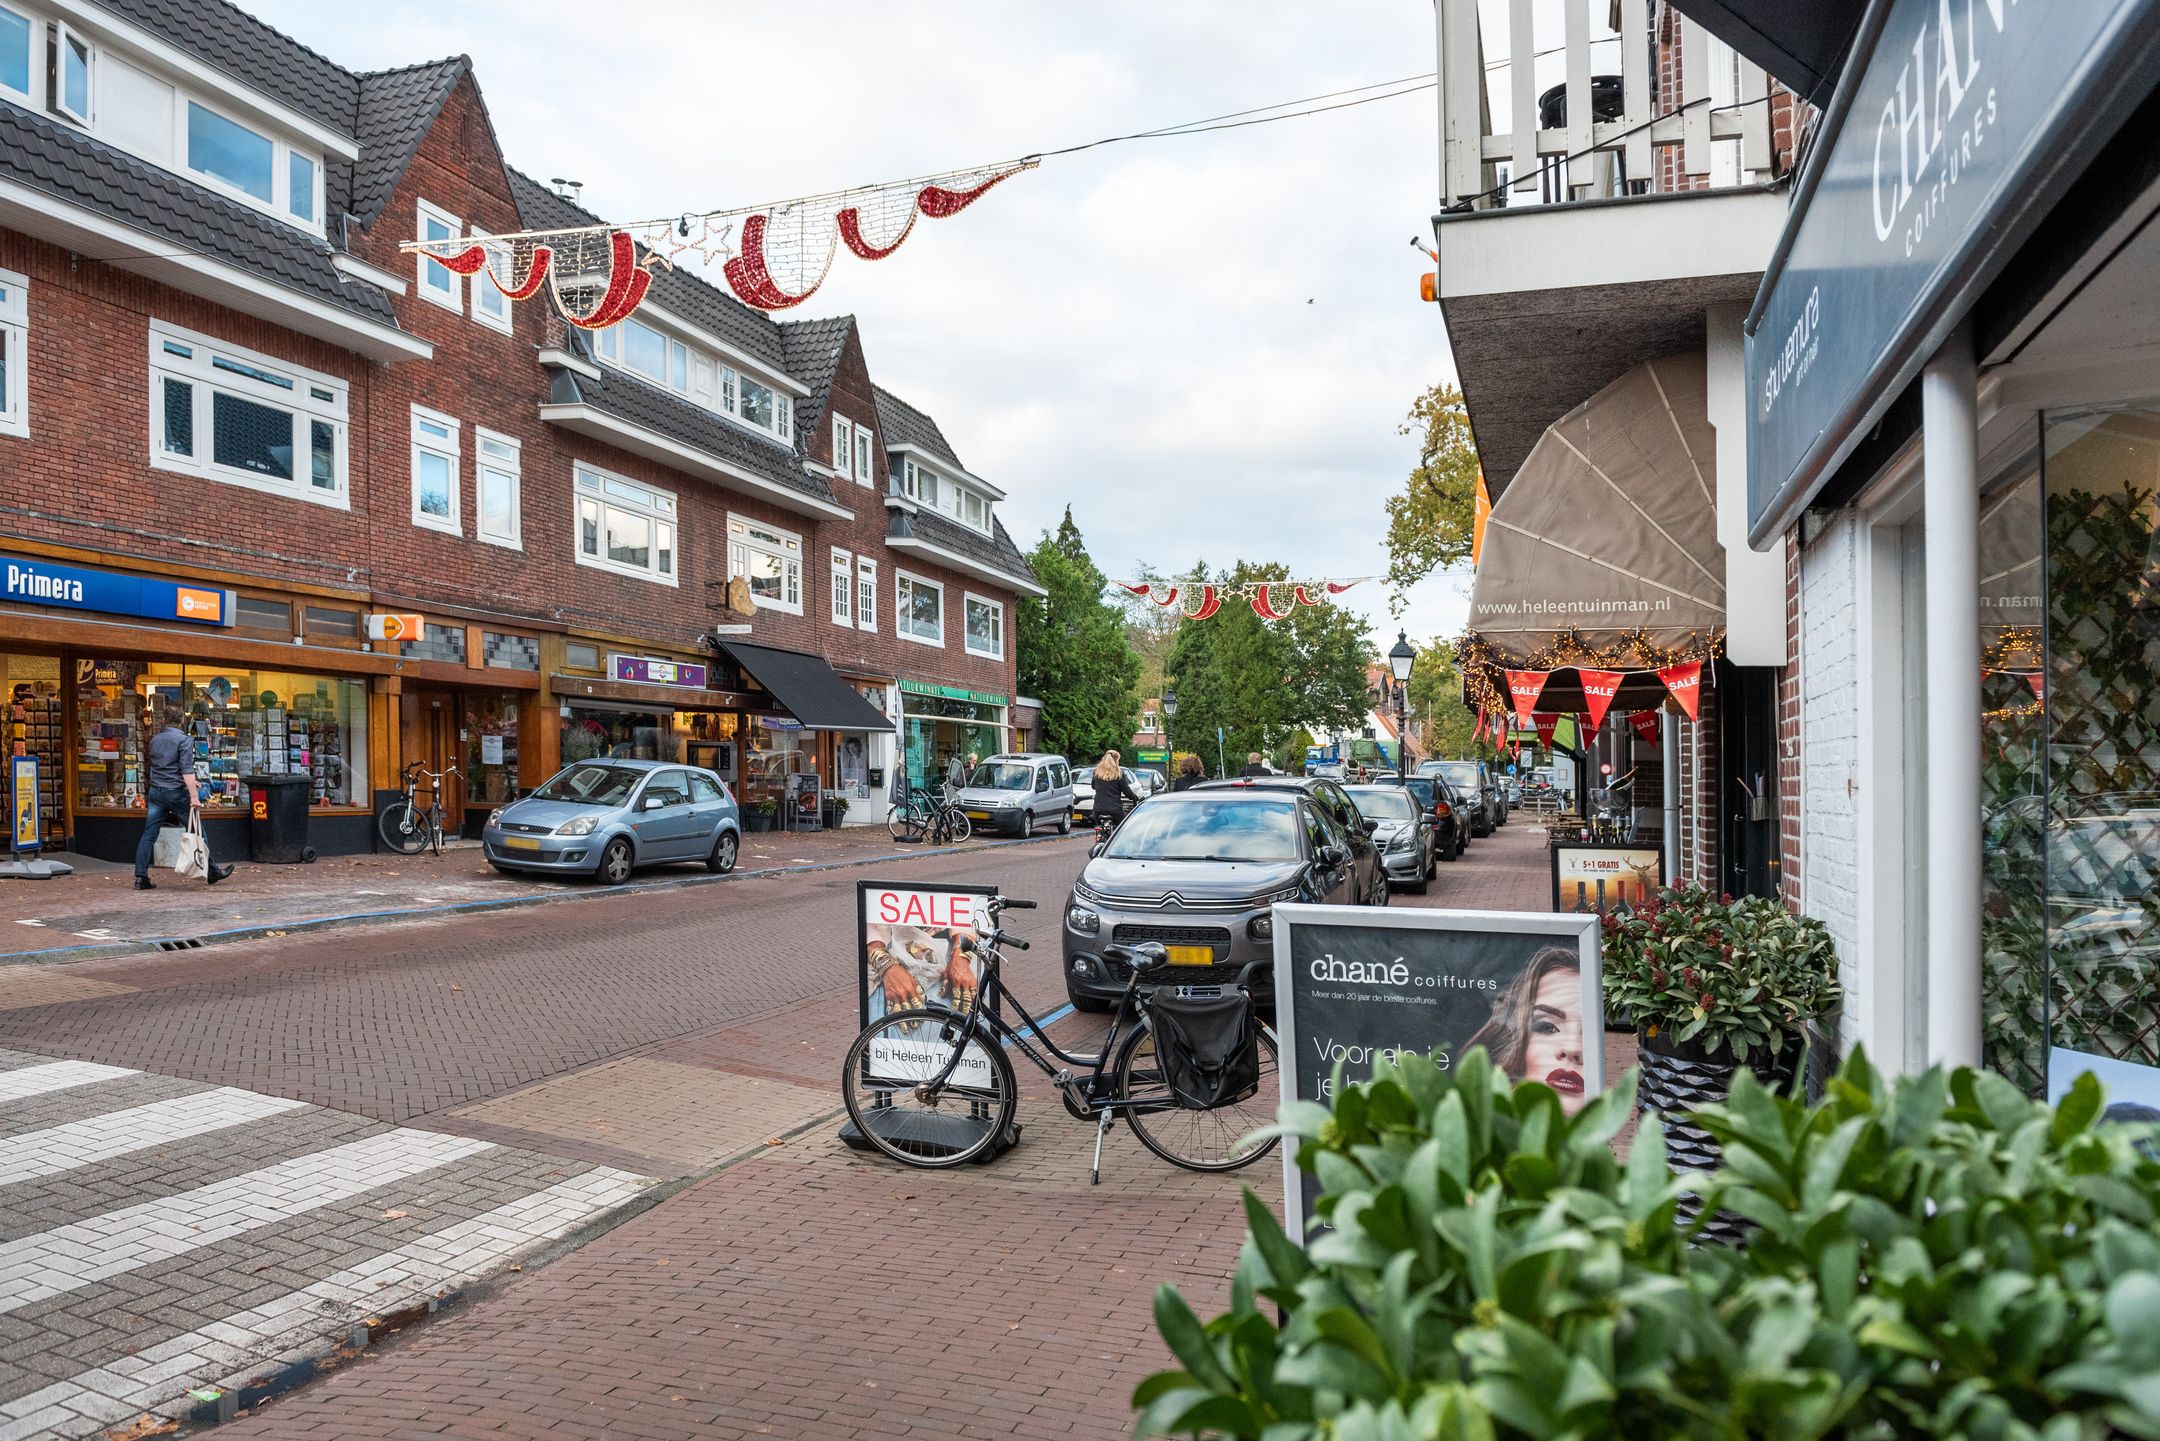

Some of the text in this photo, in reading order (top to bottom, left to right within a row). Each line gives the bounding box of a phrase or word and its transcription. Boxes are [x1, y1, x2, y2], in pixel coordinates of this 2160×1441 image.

[1873, 0, 2018, 241] CHAN
[1905, 87, 1996, 258] COIFFURES
[1765, 285, 1819, 412] shu uemura
[7, 565, 83, 602] Primera
[1477, 597, 1670, 614] www.heleentuinman.nl
[95, 668, 117, 679] Primera
[900, 681, 941, 696] ATUURWINKEL
[1511, 686, 1540, 696] SALE
[1584, 686, 1614, 697] SALE
[1668, 676, 1699, 691] SALE
[970, 692, 1007, 705] NATUURWINKEL
[1636, 720, 1656, 731] SALE
[1583, 861, 1620, 869] 5+1 GRATIS
[880, 892, 972, 928] SALE
[1310, 954, 1497, 990] chané coiffures
[1311, 990, 1329, 998] Meer
[1331, 991, 1345, 1000] dan
[1346, 992, 1357, 1000] 20
[1357, 993, 1371, 1002] jaar
[1383, 995, 1405, 1003] beste
[875, 1047, 986, 1069] bij Heleen Tuman
[1313, 1036, 1374, 1065] Voor
[1382, 1043, 1417, 1067] al
